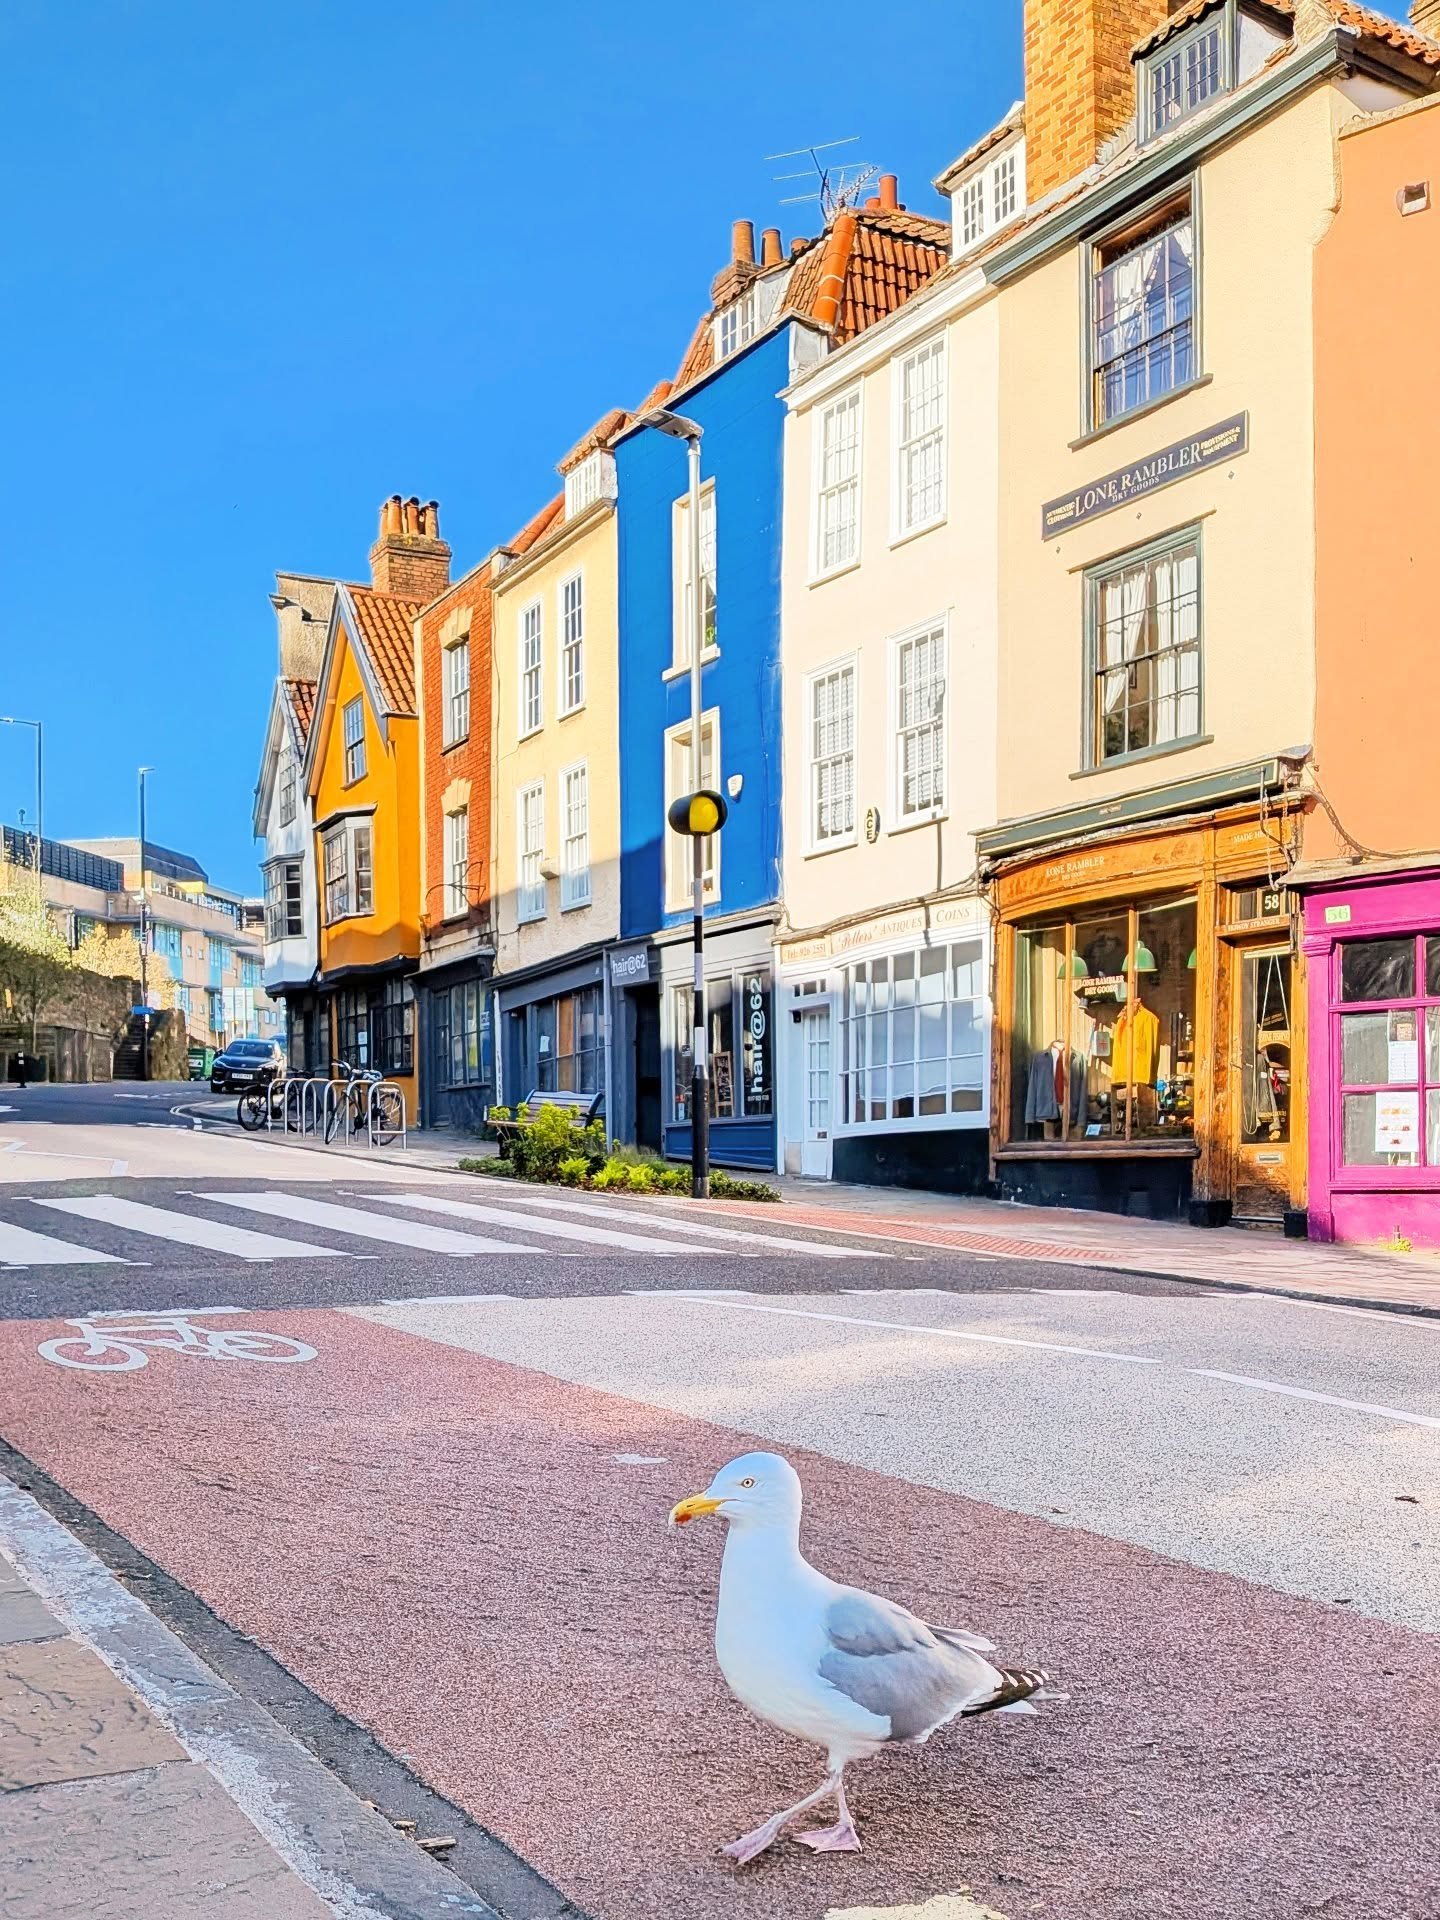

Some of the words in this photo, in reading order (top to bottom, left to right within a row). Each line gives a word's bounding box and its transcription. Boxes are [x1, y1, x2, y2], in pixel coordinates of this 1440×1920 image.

[1074, 480, 1118, 517] LONE
[1121, 442, 1202, 491] RAMBLER
[1112, 491, 1129, 503] DRY
[1131, 476, 1160, 493] GOODS
[1233, 832, 1253, 844] MADE
[1046, 864, 1065, 877] LONE
[1066, 856, 1105, 873] RAMBLER
[1264, 894, 1280, 910] 58
[936, 906, 971, 923] COINS
[1250, 917, 1280, 928] STRANGER
[1327, 907, 1349, 922] 56
[880, 916, 922, 936] ANTIQUES
[612, 954, 646, 974] hair@62
[1096, 975, 1124, 985] RAMBLER
[750, 977, 766, 1093] hair@62
